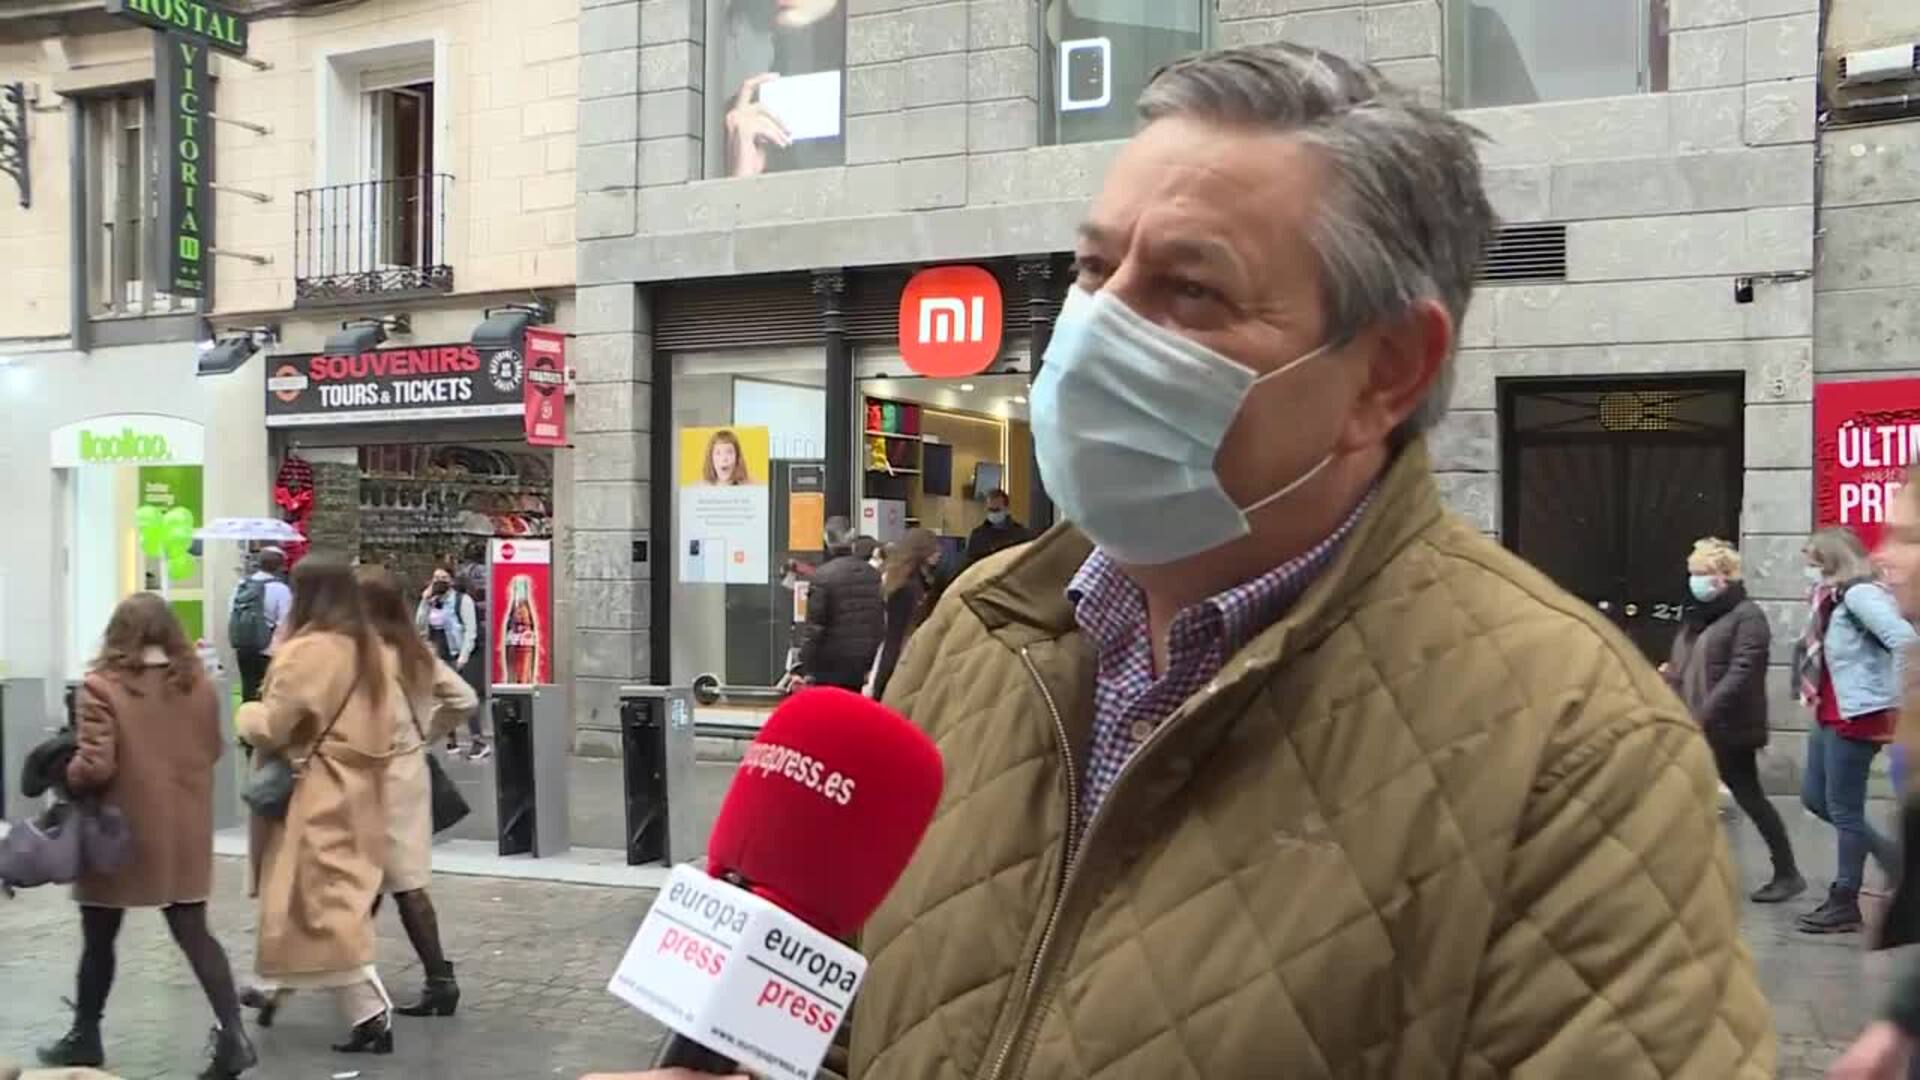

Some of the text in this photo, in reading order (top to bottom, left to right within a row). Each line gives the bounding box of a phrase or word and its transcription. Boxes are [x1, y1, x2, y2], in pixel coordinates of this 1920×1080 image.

[180, 43, 199, 231] VICTORIA
[310, 347, 481, 381] SOUVENIRS
[319, 383, 379, 408] TOURS
[393, 377, 472, 403] TICKETS
[669, 881, 749, 935] europa
[656, 927, 726, 976] press
[764, 927, 858, 993] europa
[757, 978, 838, 1034] press
